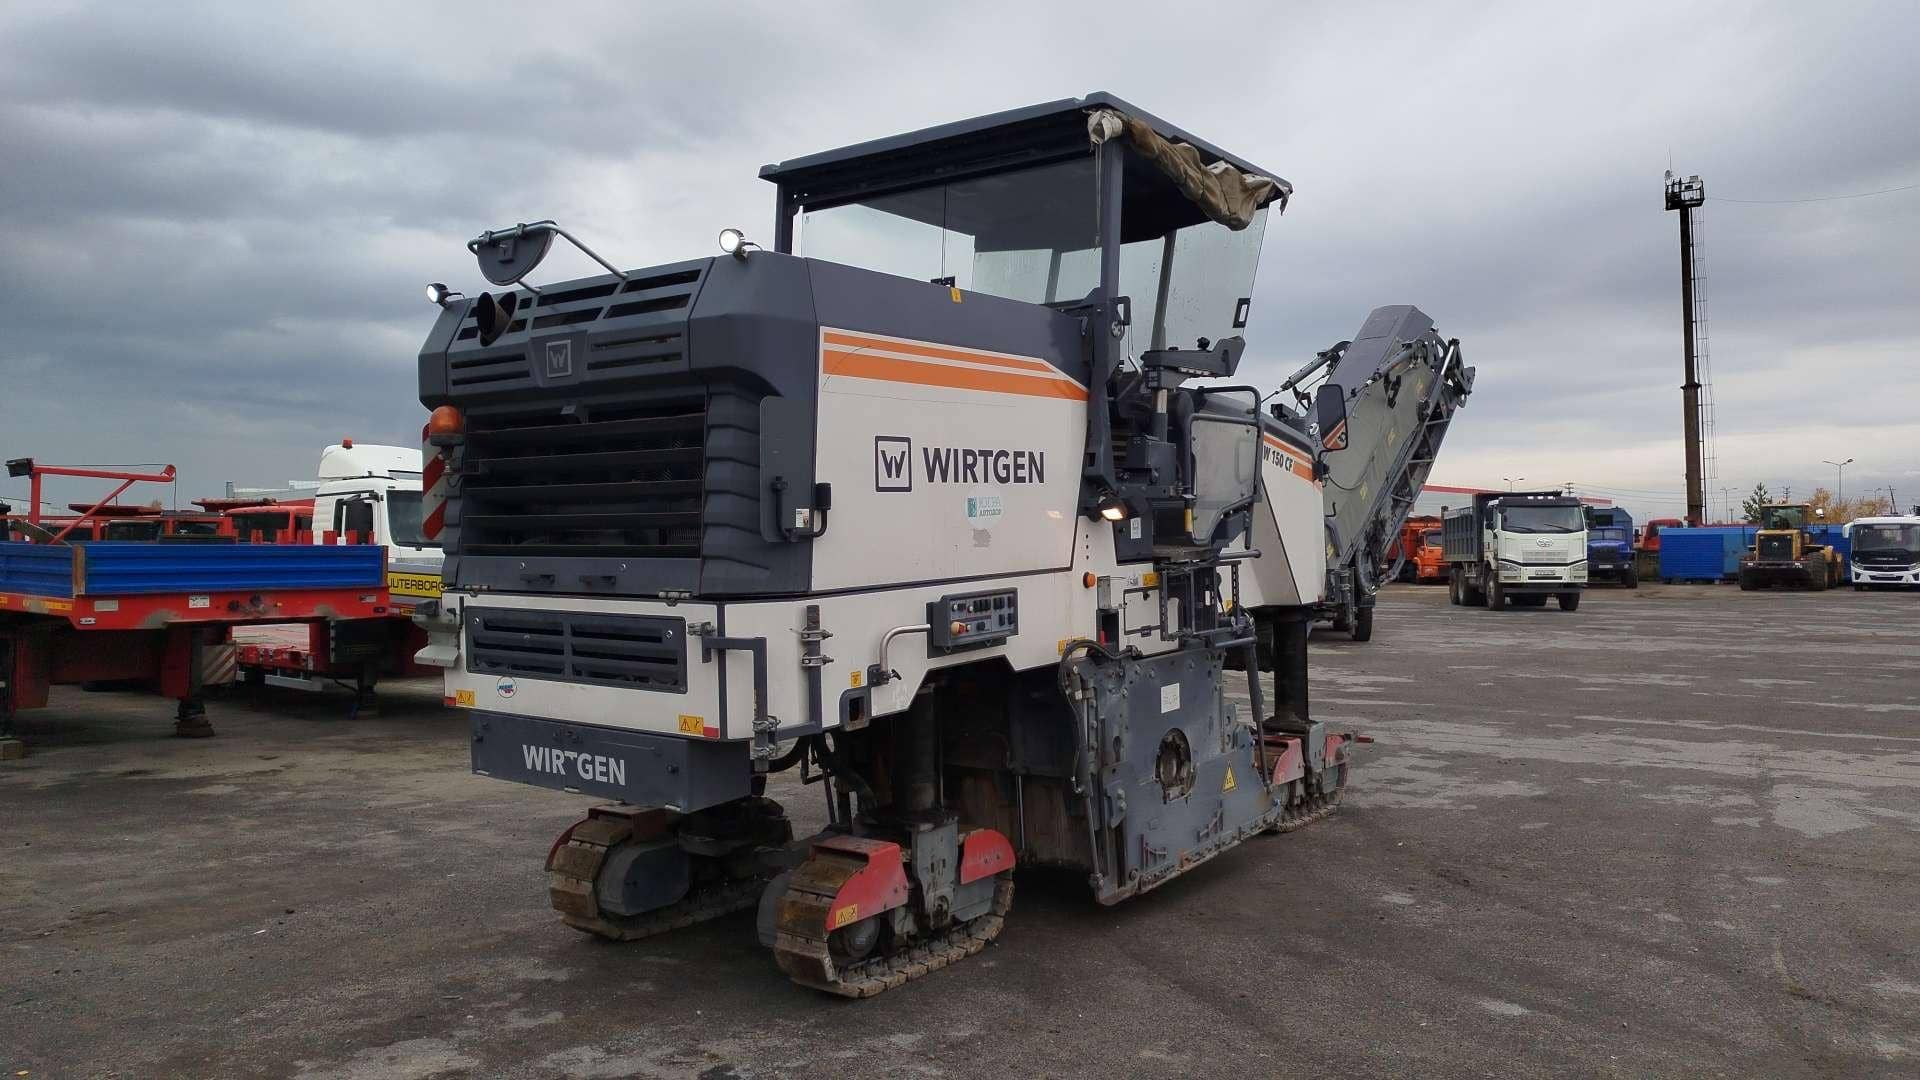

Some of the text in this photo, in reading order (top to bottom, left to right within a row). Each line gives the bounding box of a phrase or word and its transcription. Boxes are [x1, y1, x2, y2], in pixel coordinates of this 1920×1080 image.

[922, 447, 1045, 484] WIRTGEN
[1272, 450, 1284, 468] 150
[1285, 456, 1293, 472] CF
